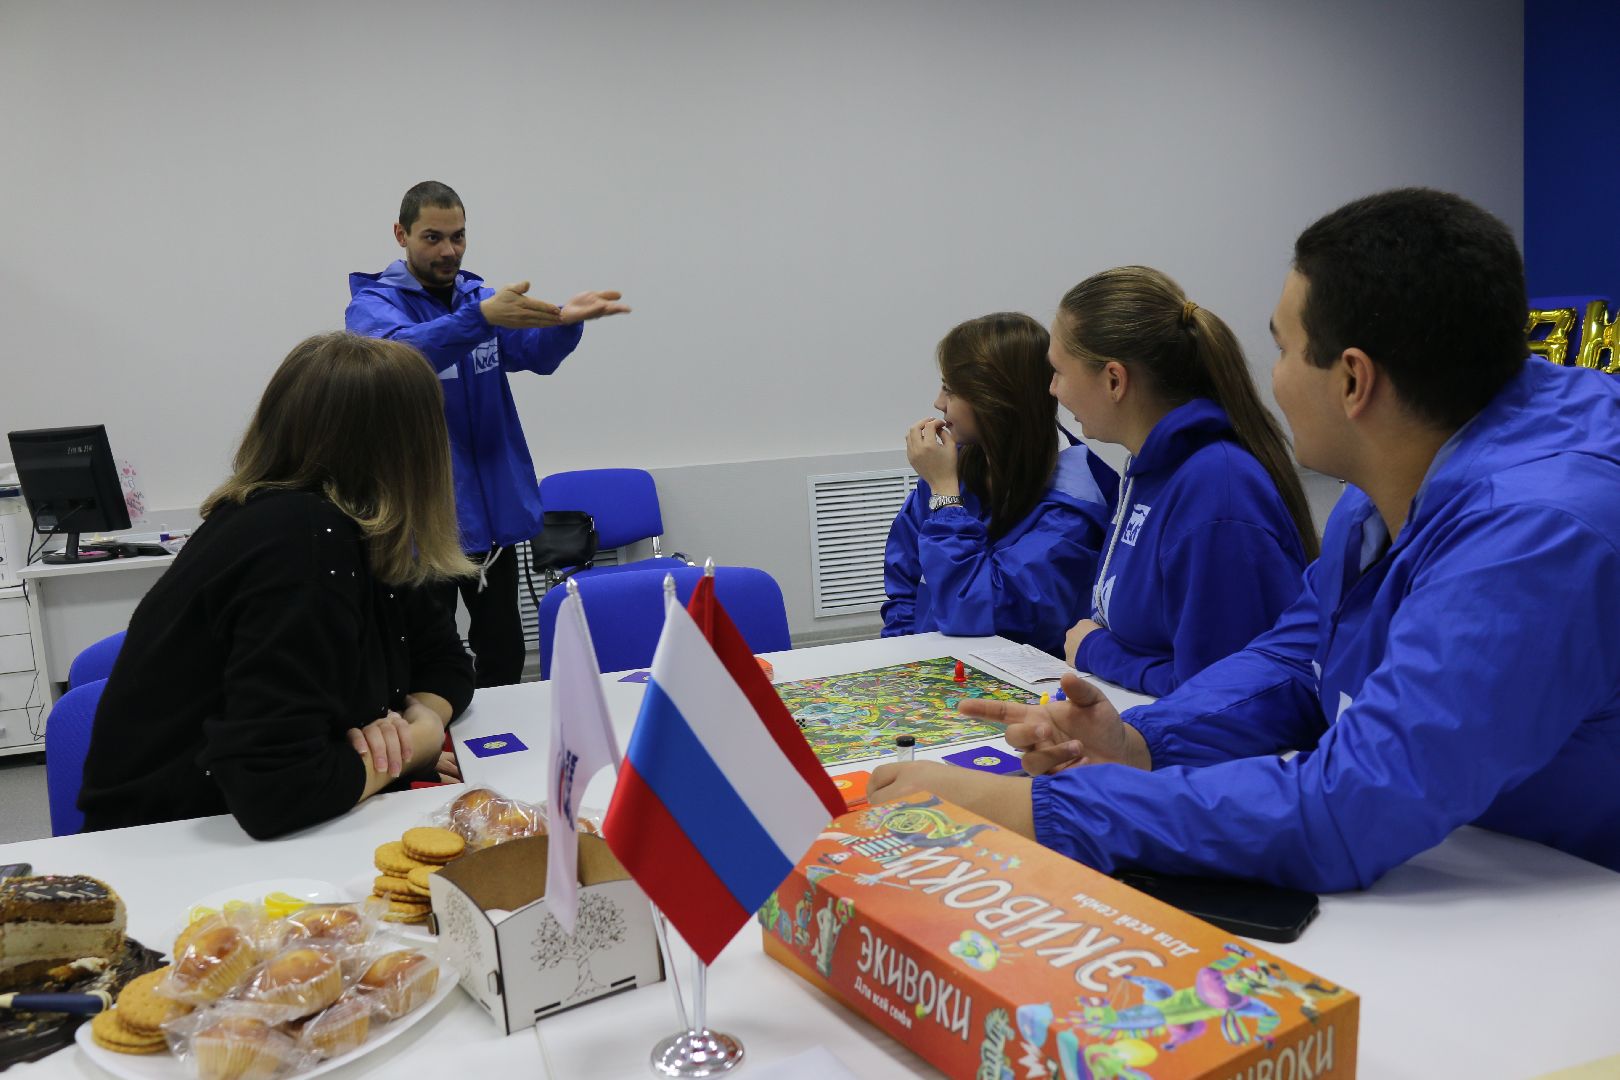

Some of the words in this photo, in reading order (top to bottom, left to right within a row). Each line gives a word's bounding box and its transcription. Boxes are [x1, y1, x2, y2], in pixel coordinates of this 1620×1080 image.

[1071, 892, 1119, 918] семьи
[881, 845, 1164, 993] ЭКИВОКИ
[1112, 914, 1156, 936] всей
[1152, 931, 1200, 958] Для
[853, 975, 872, 1000] Для
[856, 925, 972, 1041] ЭКИВОКИ
